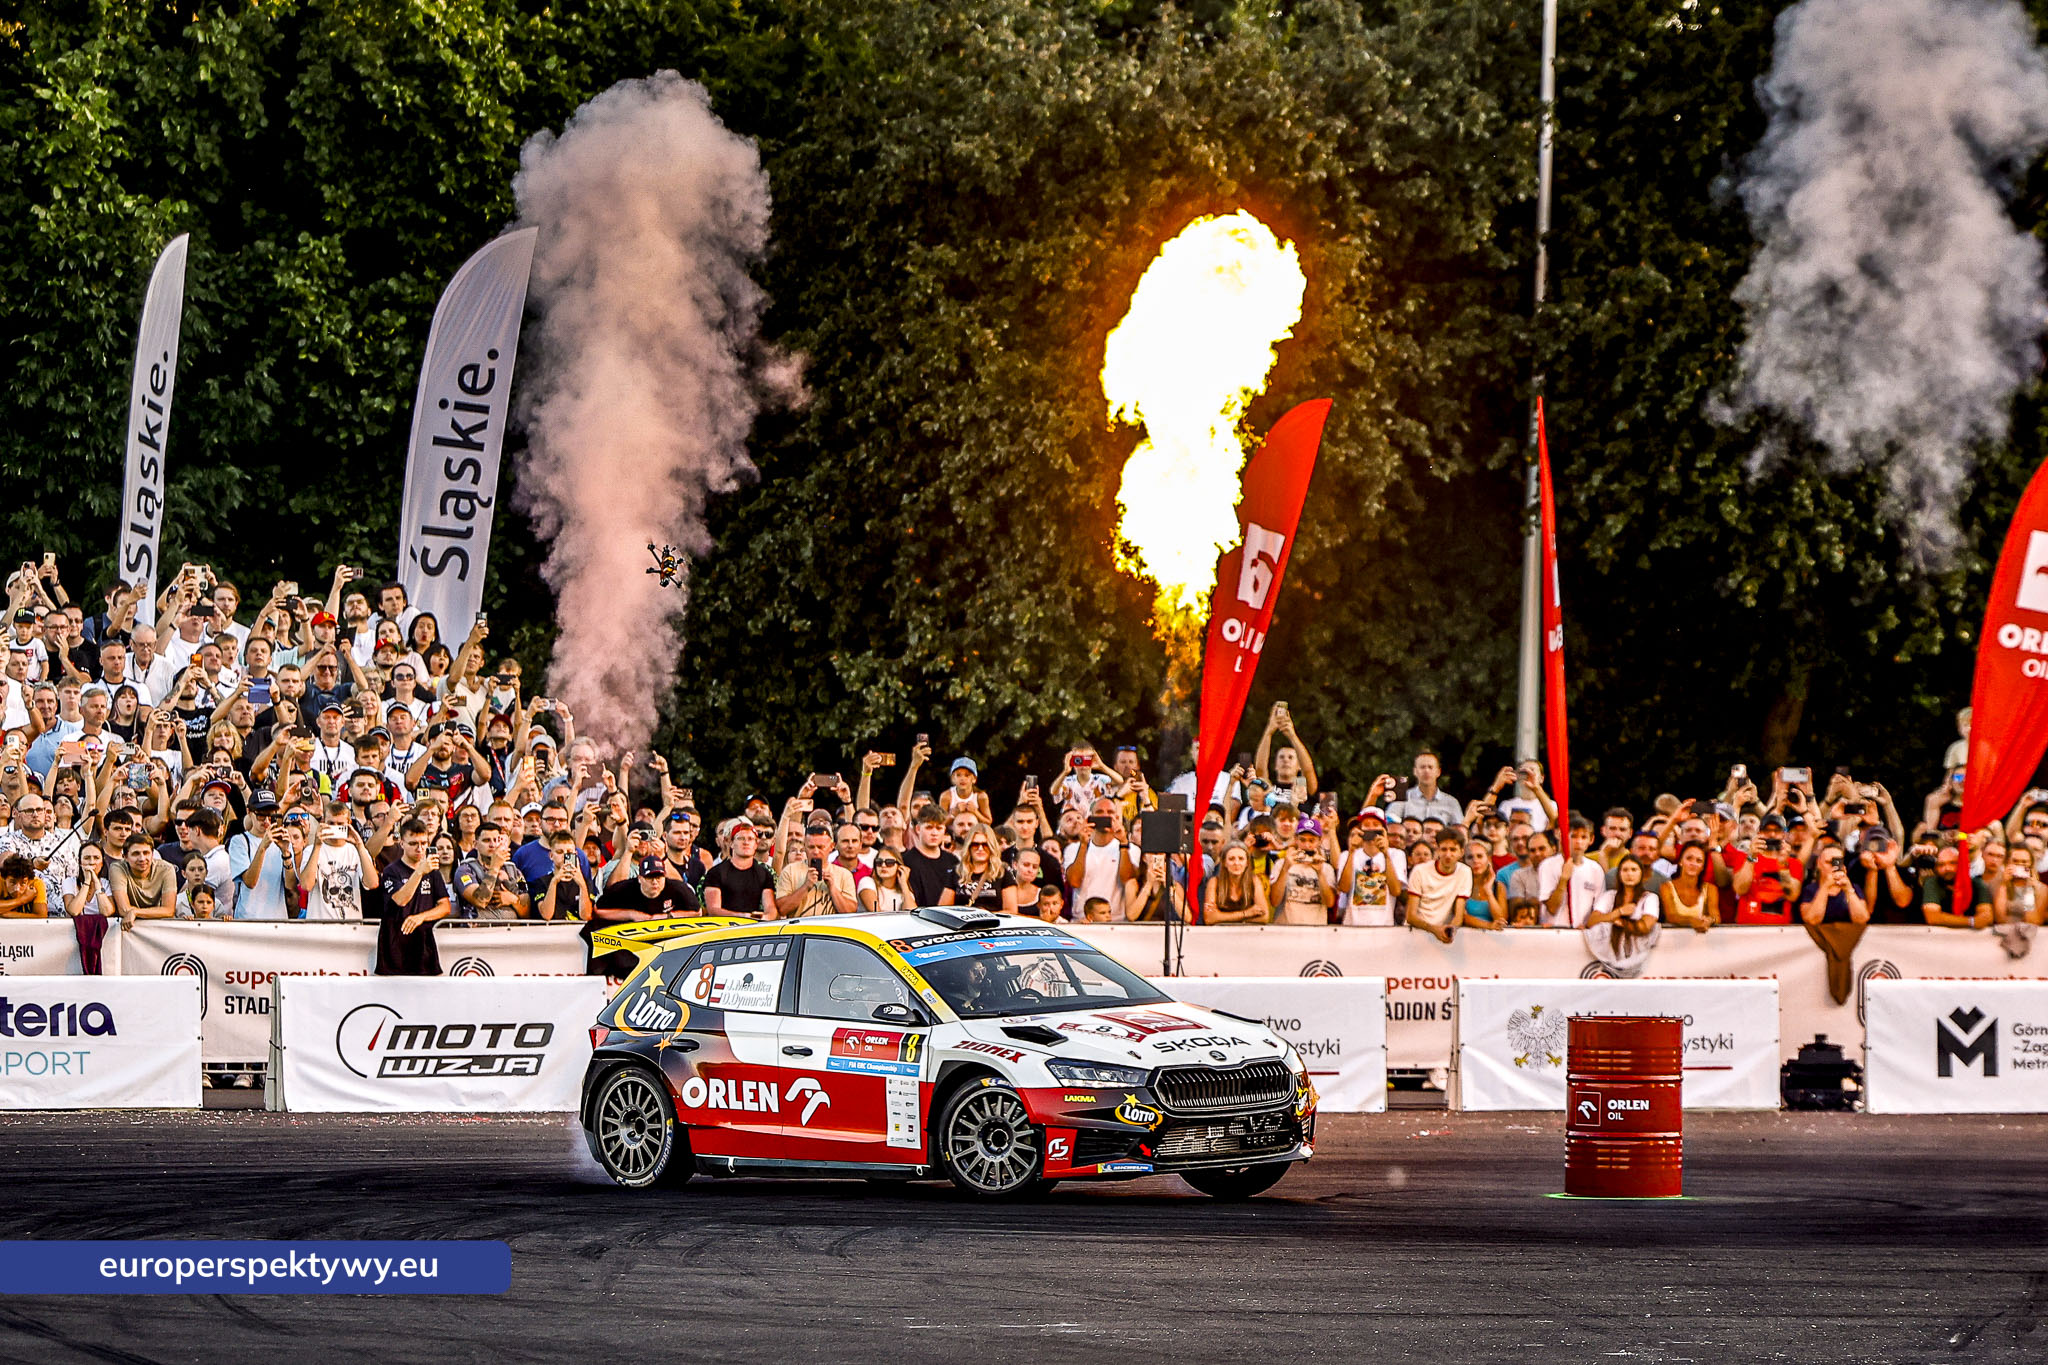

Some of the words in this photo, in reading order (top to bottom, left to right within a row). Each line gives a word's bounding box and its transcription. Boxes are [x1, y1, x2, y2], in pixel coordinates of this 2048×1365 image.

[410, 348, 500, 582] Śląskie.
[890, 940, 913, 953] 8
[695, 963, 714, 999] 8
[225, 995, 269, 1015] STAD
[628, 992, 676, 1030] LOTTO
[386, 1023, 554, 1050] MOTO
[864, 1036, 889, 1045] ORLEN
[905, 1034, 920, 1062] 8
[0, 1051, 91, 1075] PORT
[380, 1057, 540, 1076] WIZJA
[681, 1077, 779, 1113] ORLEN
[1064, 1095, 1096, 1103] LAKMA
[1607, 1100, 1650, 1111] ORLEN
[1123, 1104, 1155, 1122] LOTTO
[1608, 1112, 1624, 1121] OIL
